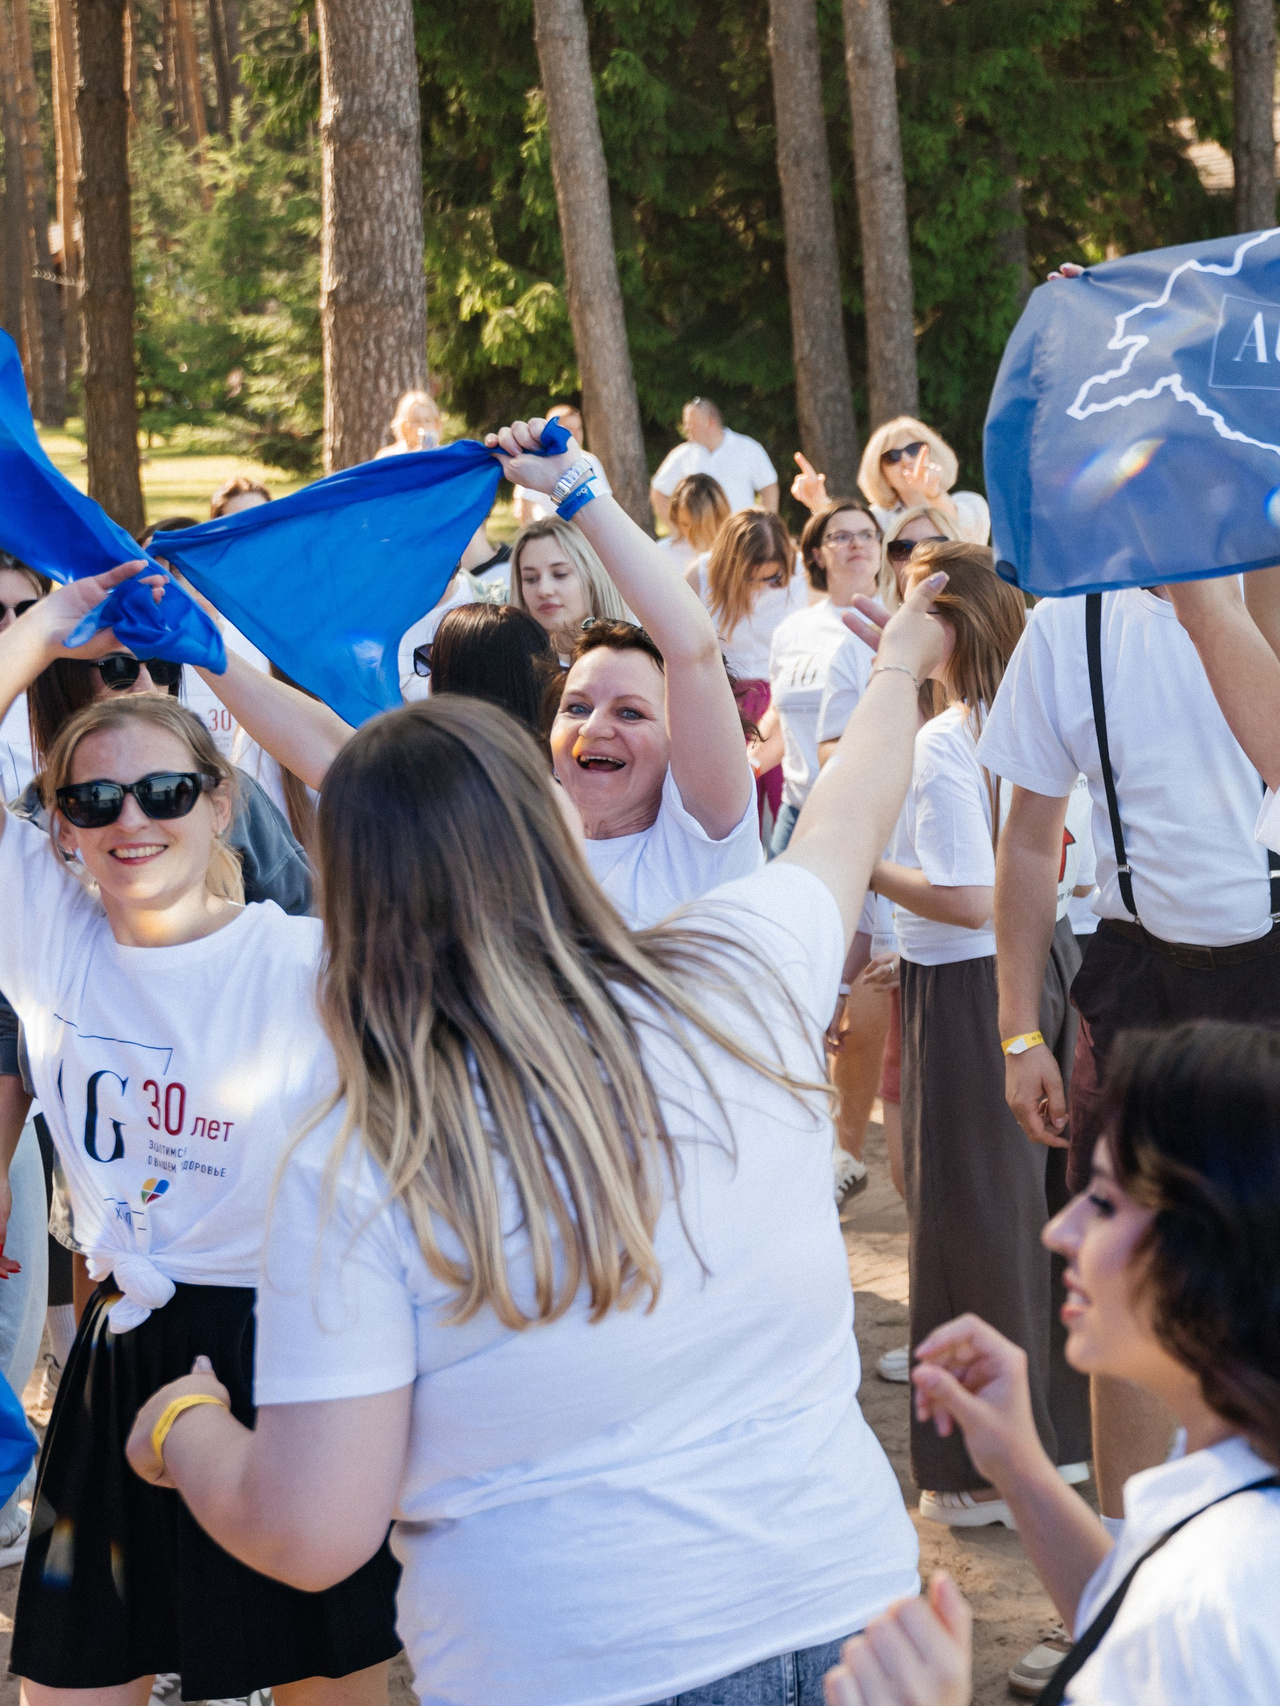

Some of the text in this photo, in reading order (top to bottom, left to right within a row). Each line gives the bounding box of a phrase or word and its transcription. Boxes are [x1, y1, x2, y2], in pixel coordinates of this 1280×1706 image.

[208, 708, 232, 732] 30
[142, 1079, 235, 1142] 30 лет
[181, 1160, 227, 1178] ДОРОВЬЕ
